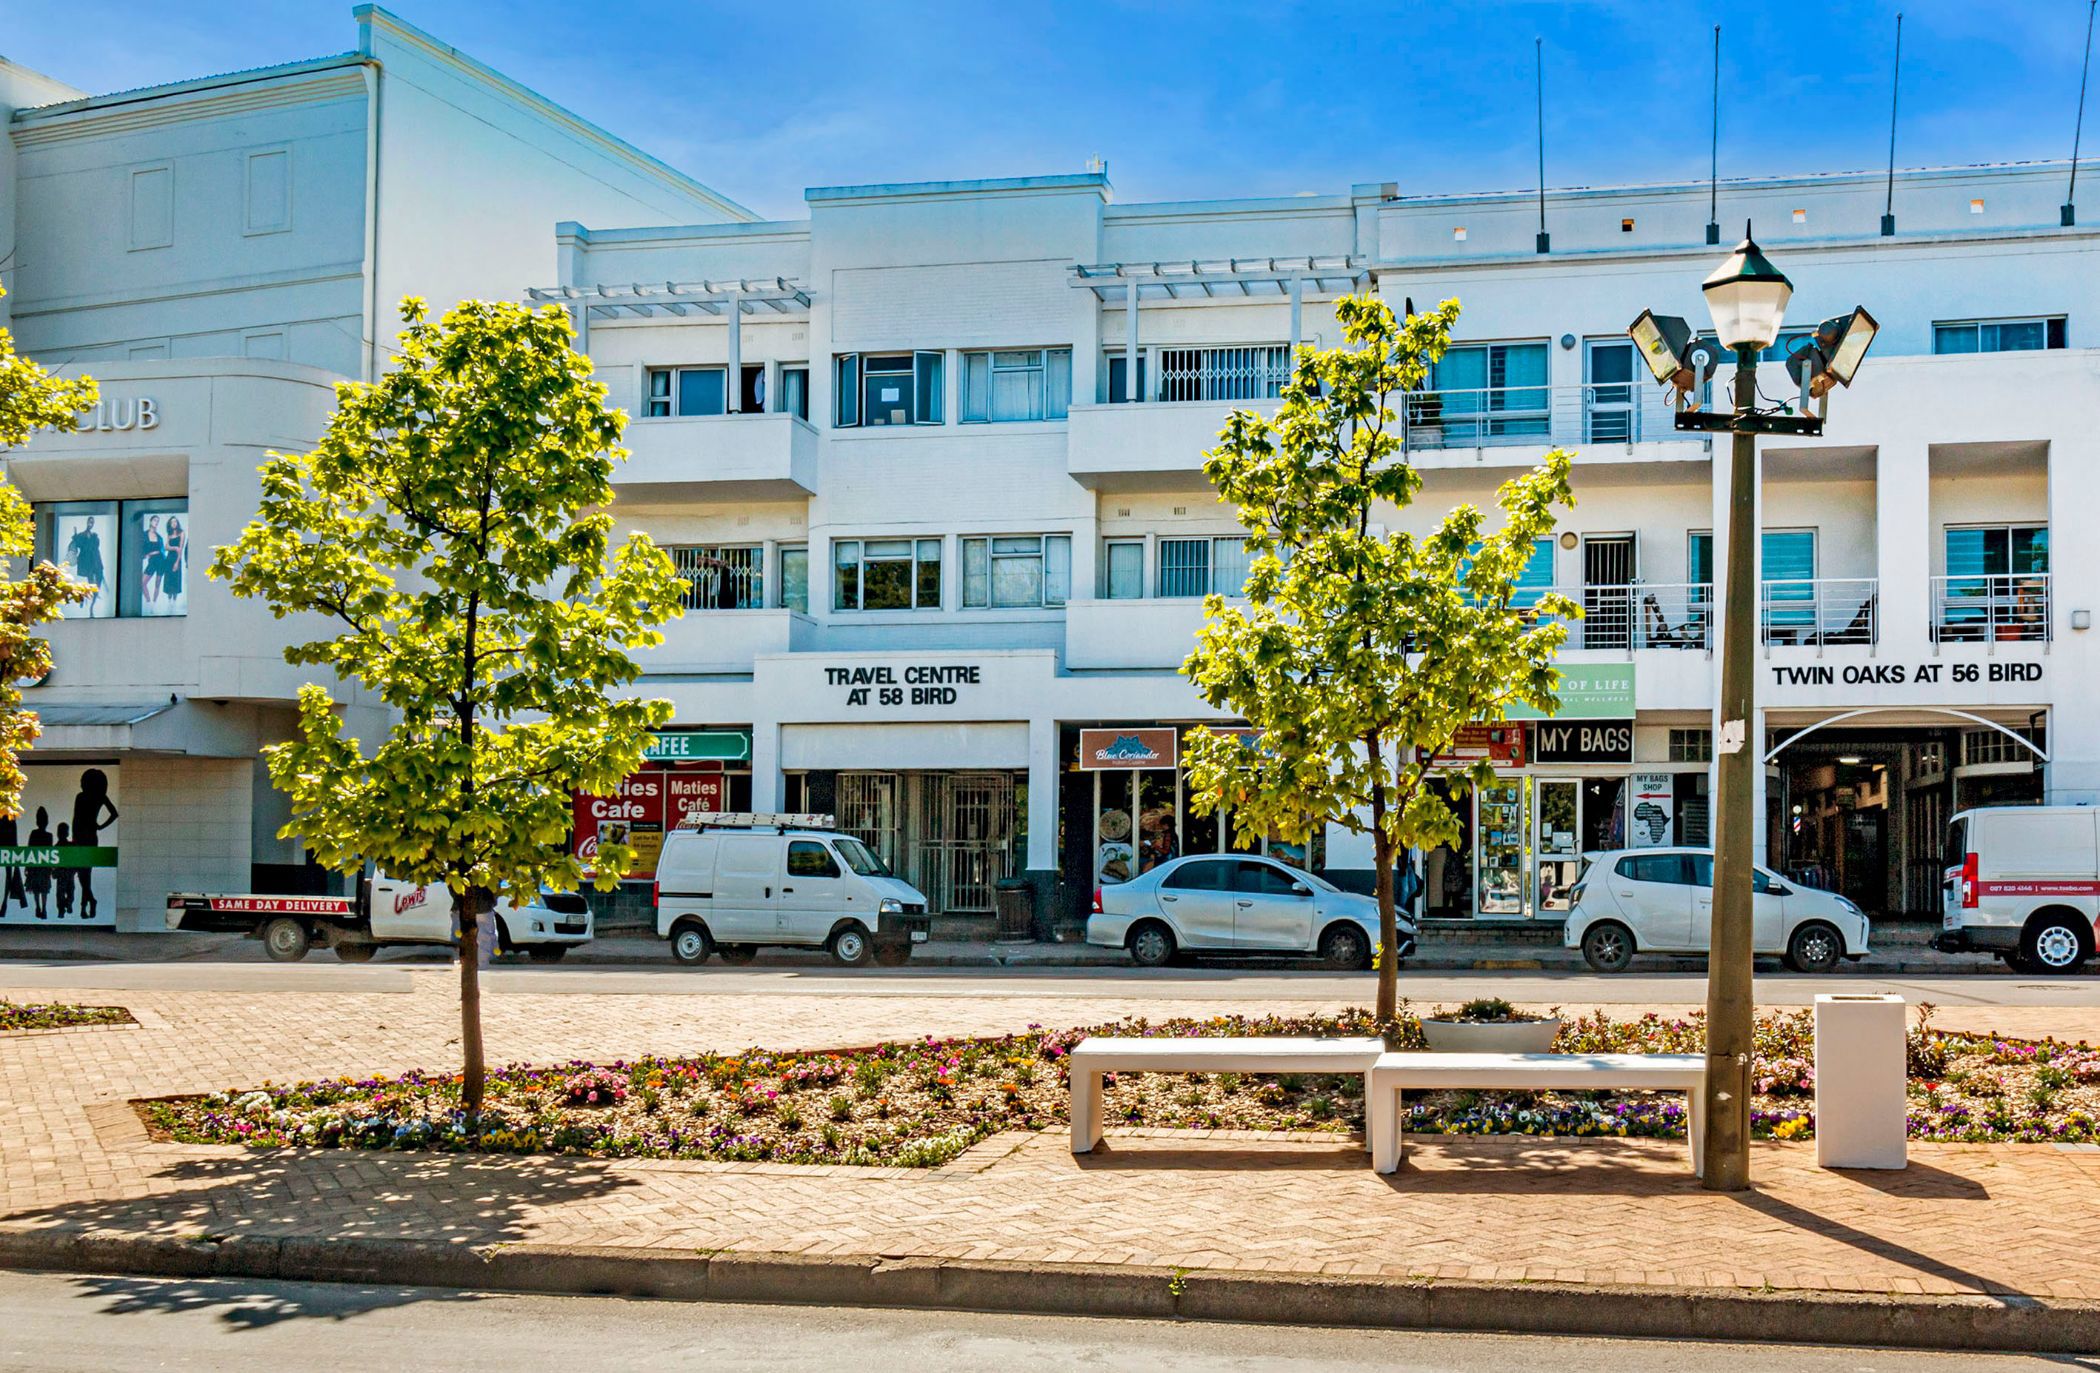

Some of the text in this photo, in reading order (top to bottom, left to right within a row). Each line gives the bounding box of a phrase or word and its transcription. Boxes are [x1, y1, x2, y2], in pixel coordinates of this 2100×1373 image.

[824, 666, 980, 685] TRAVEL CENTRE
[1772, 663, 2043, 685] TWIN OAKS AT 56 BIRD
[1568, 680, 1630, 690] OF LIFE
[847, 687, 957, 705] AT 58 BIRD
[643, 737, 690, 755] AFEE
[1541, 727, 1630, 752] MY BAGS
[1096, 749, 1159, 760] Blue Coriander
[671, 780, 717, 795] Maties
[591, 798, 710, 818] Cafe Café
[218, 899, 342, 912] SAME DAY DELIVERY
